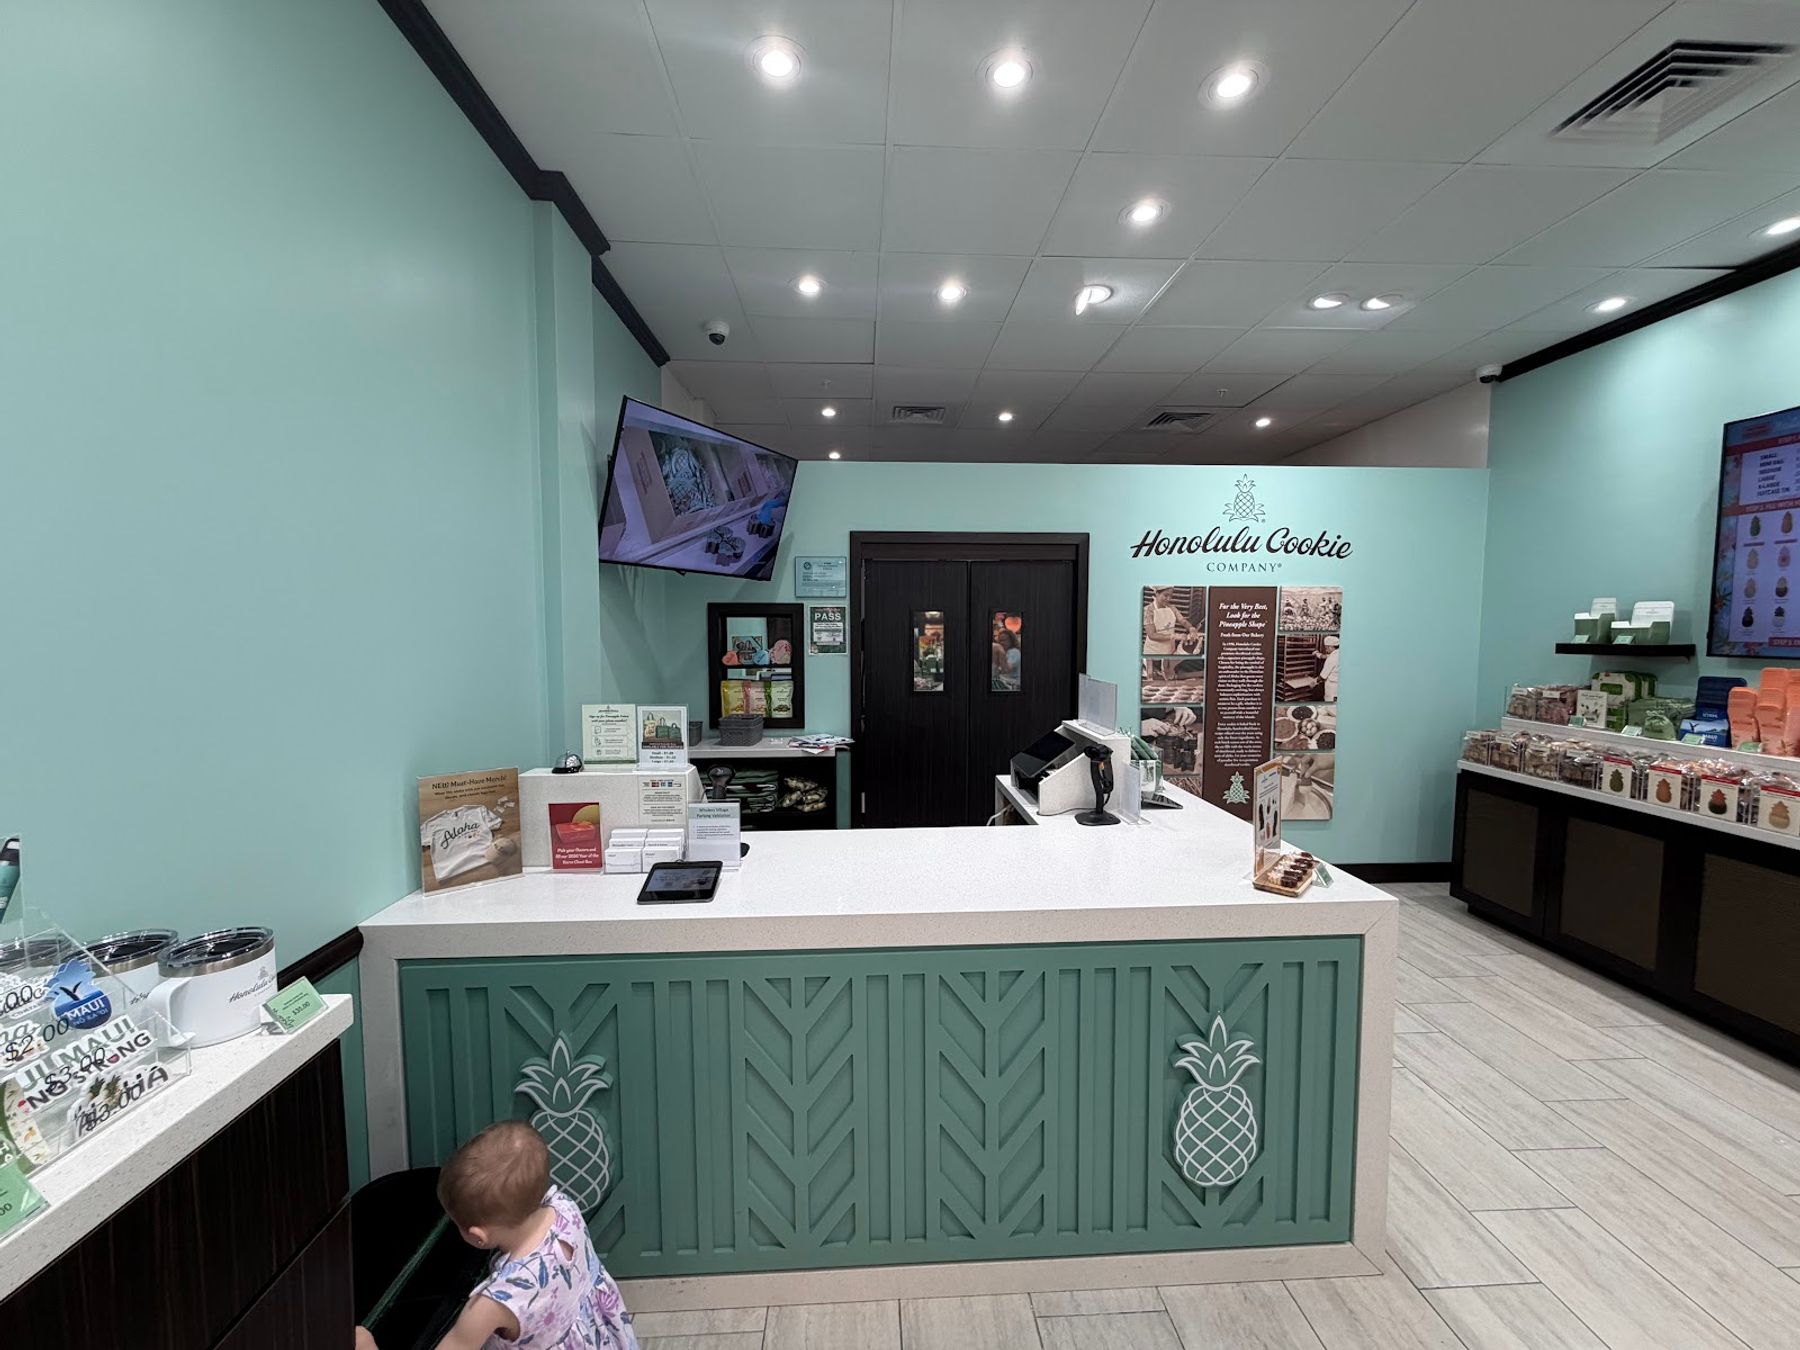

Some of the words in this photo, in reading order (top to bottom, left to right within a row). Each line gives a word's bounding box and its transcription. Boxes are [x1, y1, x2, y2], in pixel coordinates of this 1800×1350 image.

[1130, 526, 1262, 558] Honolulu
[1266, 527, 1353, 559] Cookie
[1219, 602, 1230, 610] For
[1230, 602, 1240, 610] the
[1241, 602, 1254, 611] Very
[814, 612, 842, 620] PASS
[1240, 611, 1251, 620] for
[1219, 620, 1247, 629] Pineapple
[441, 822, 480, 849] Aloha
[68, 998, 106, 1020] MAUI
[45, 1047, 106, 1092] $3.00
